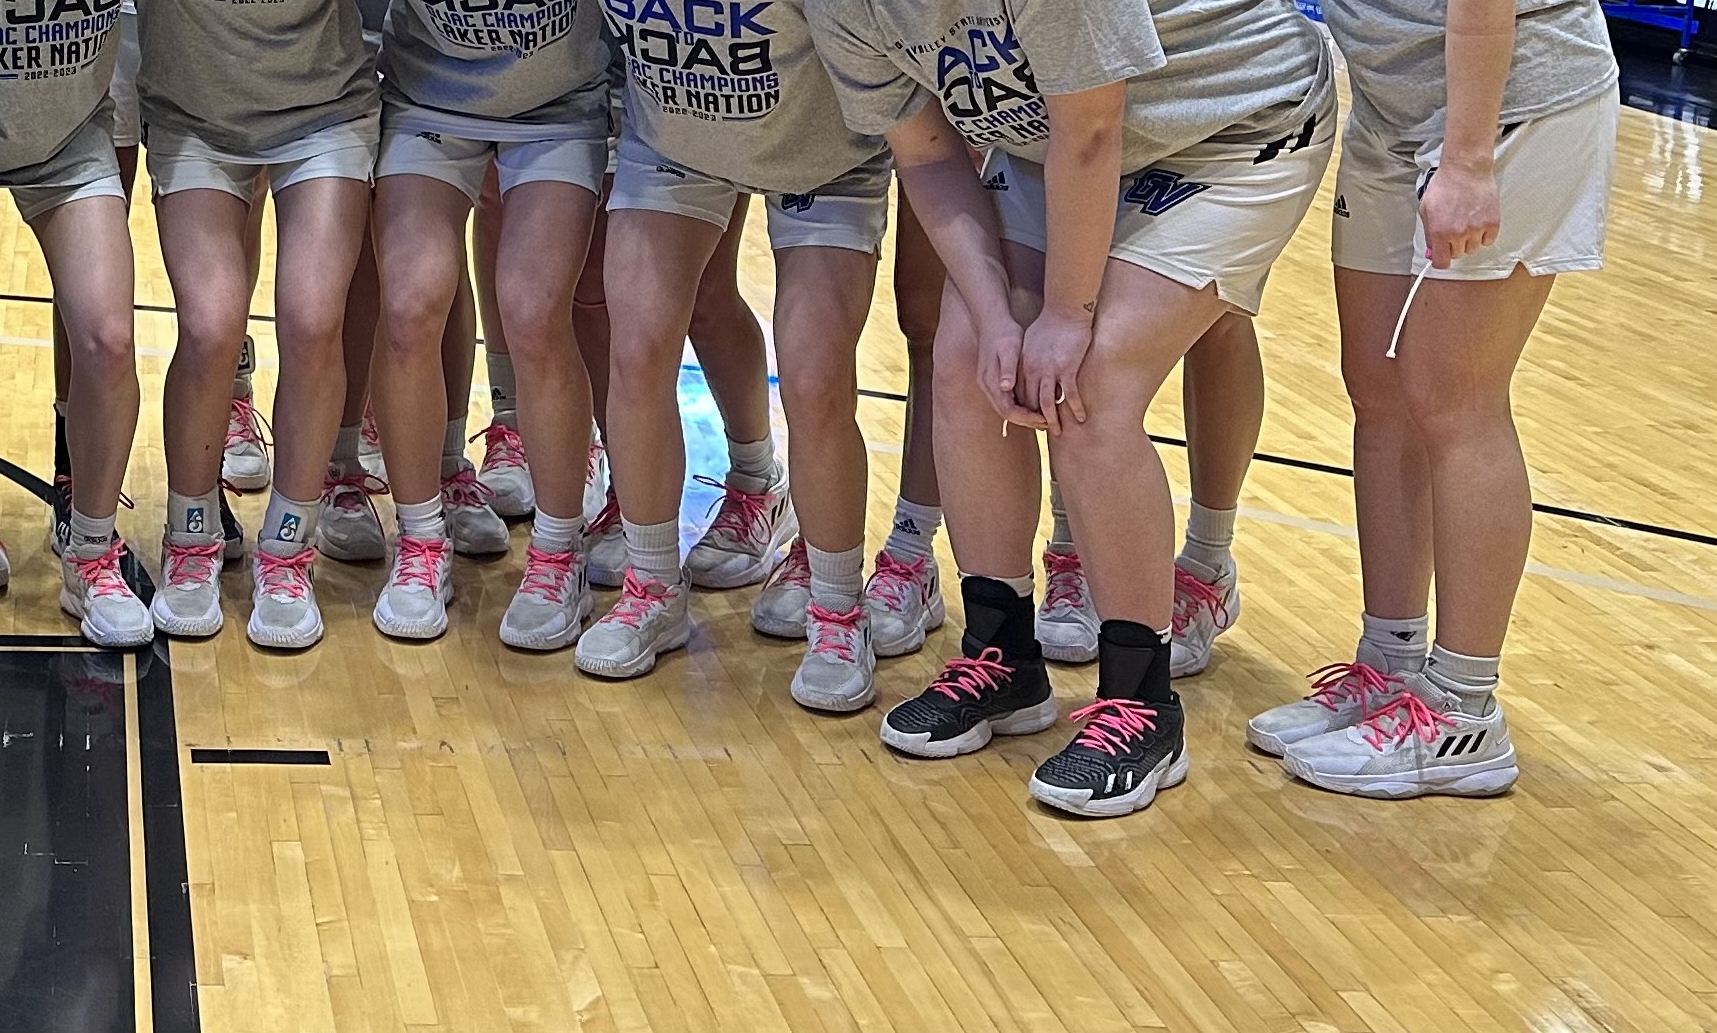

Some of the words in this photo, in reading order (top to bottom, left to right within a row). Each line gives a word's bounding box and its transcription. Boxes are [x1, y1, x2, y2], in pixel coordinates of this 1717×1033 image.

[25, 4, 121, 44] CHAMPIONS
[673, 28, 694, 46] TO
[660, 68, 779, 93] CHAMPIONS
[686, 89, 780, 114] NATION
